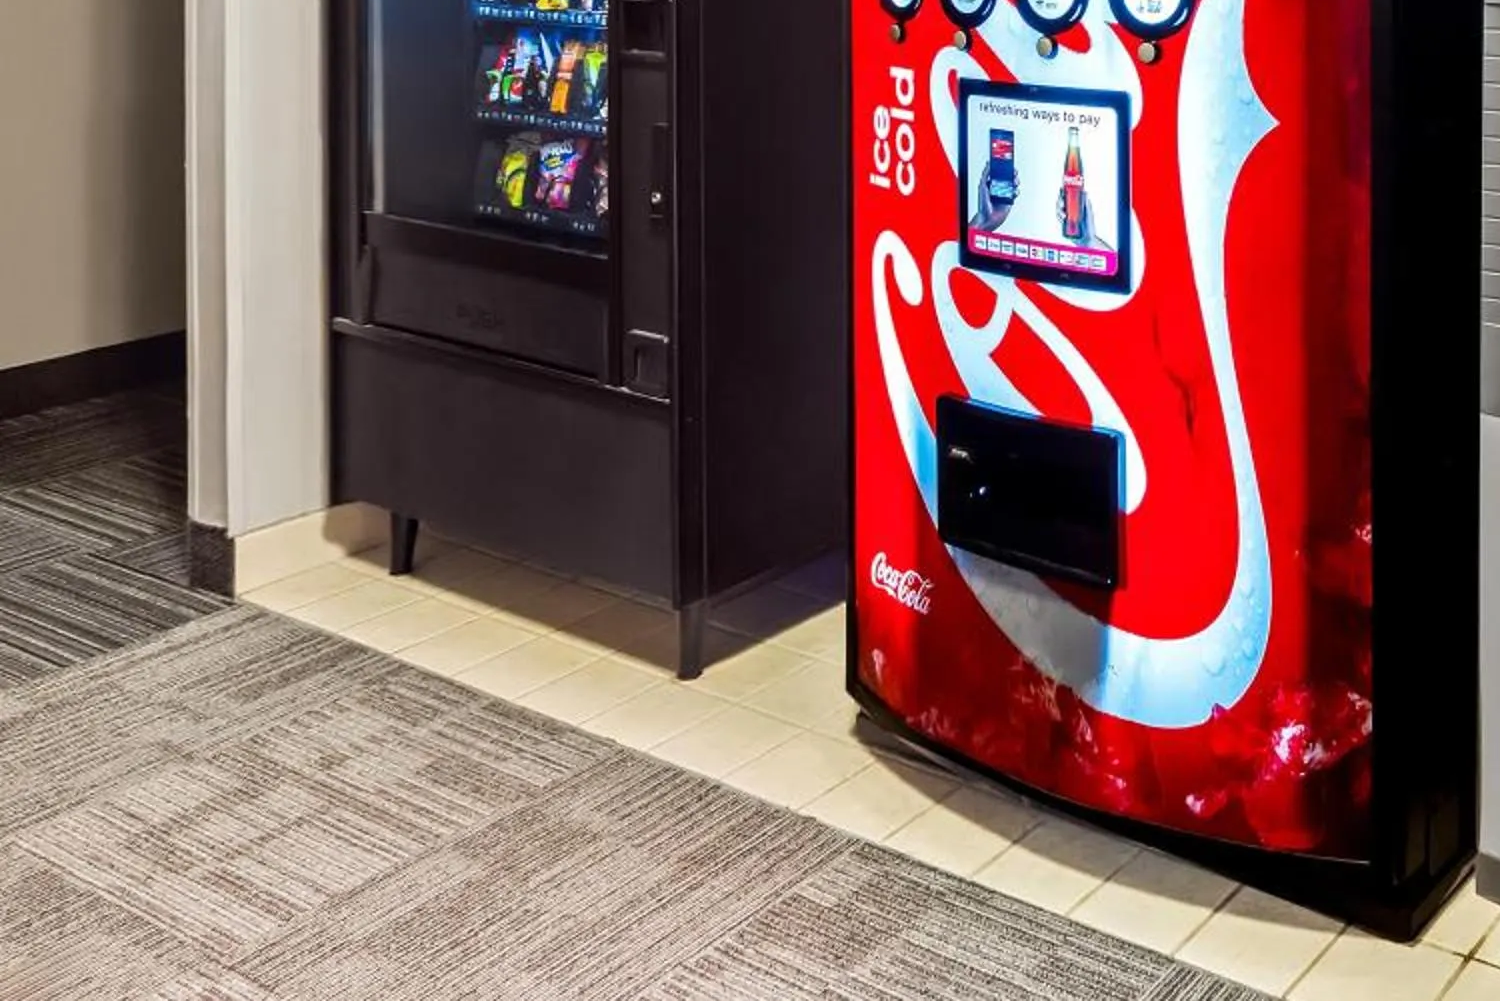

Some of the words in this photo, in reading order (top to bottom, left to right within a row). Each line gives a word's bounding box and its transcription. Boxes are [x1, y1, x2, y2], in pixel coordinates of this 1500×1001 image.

[869, 104, 891, 189] ice
[889, 65, 915, 196] cold
[979, 102, 1029, 120] refreshing
[1031, 110, 1060, 123] ways
[1063, 109, 1076, 124] to
[1078, 114, 1102, 128] pay
